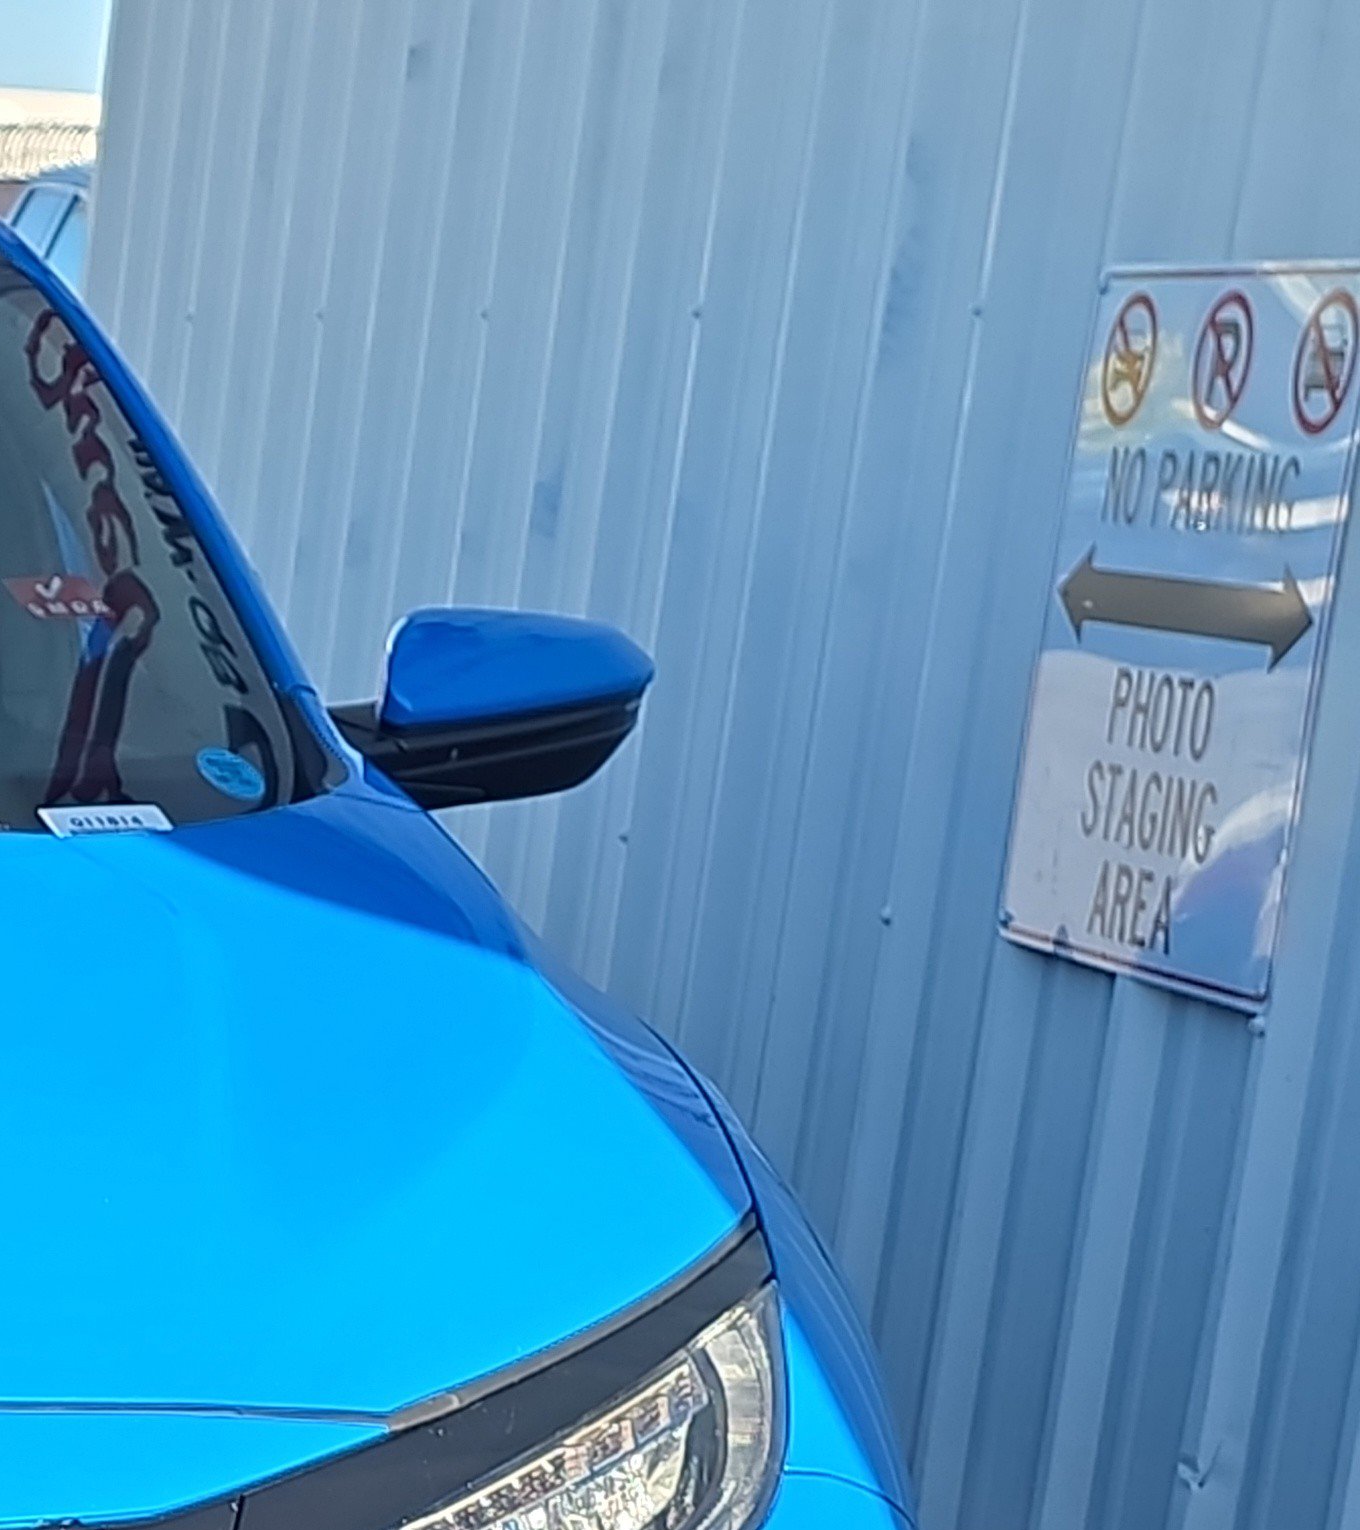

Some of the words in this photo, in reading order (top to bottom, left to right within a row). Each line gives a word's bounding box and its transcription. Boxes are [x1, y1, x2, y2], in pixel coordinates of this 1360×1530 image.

[1106, 447, 1147, 526] NO
[1151, 448, 1300, 532] PARKING
[1107, 667, 1216, 761] PHOTO
[1081, 761, 1217, 865] STAGING
[1088, 861, 1173, 955] AREA
